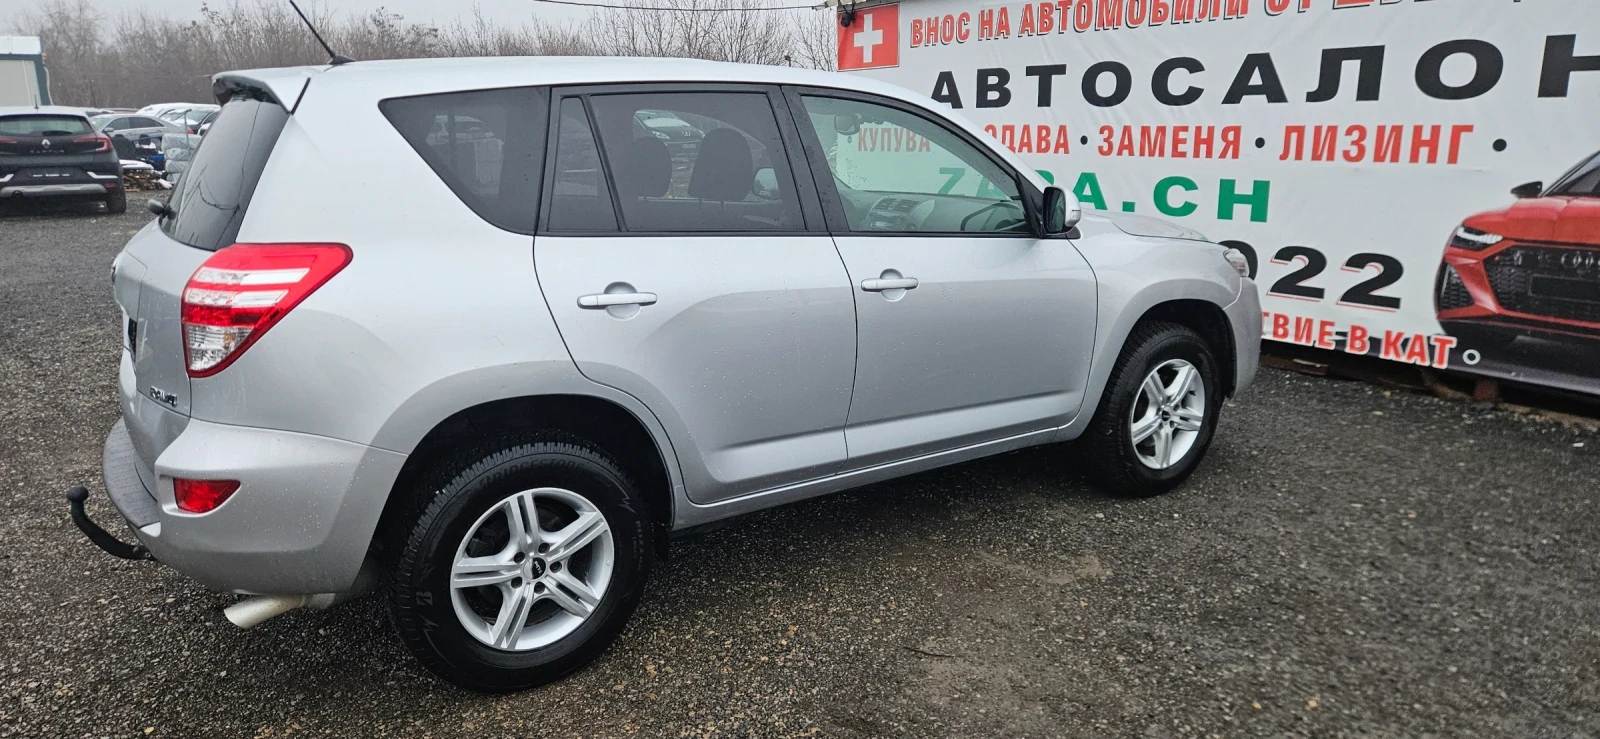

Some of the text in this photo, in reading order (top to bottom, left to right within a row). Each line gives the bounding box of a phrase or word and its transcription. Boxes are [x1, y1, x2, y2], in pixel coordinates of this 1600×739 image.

[910, 12, 971, 48] ВНОС
[978, 6, 1011, 41] НА
[858, 127, 931, 152] КУПУВА
[1098, 125, 1242, 160] ЗАМЕНЯ
[1279, 124, 1474, 164] ЛИЗИНГ
[1346, 324, 1371, 354] В
[1380, 329, 1457, 369] КАТ
